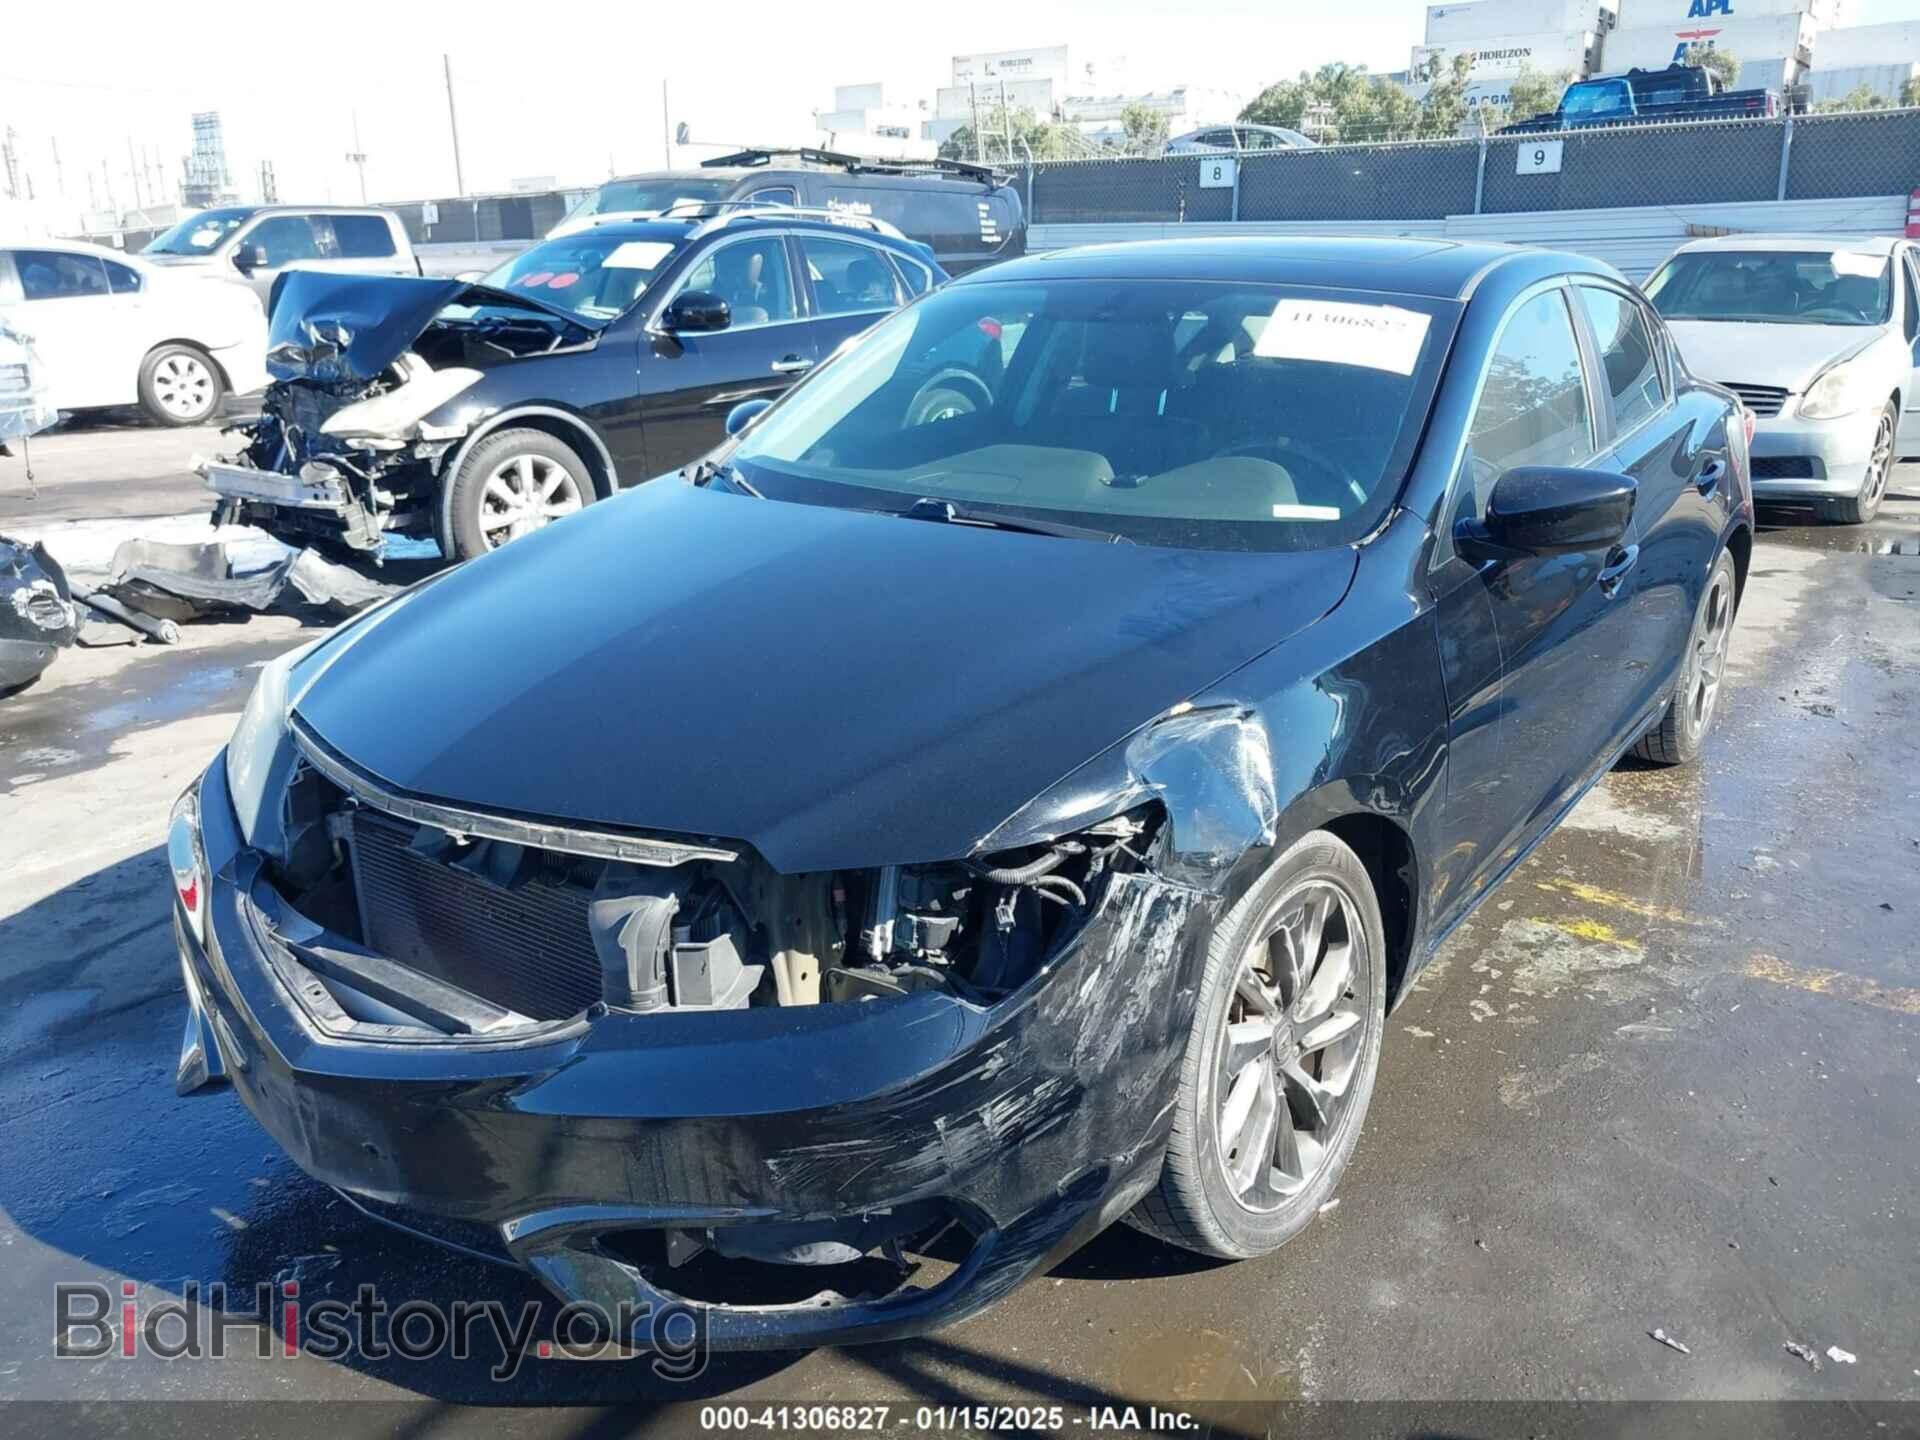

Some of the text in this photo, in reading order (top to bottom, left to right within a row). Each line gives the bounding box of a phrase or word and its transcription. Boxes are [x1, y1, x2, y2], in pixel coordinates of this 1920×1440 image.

[1687, 0, 1734, 18] APL
[1479, 47, 1532, 61] HORIZON
[1534, 149, 1545, 166] 9
[1213, 166, 1221, 181] 8
